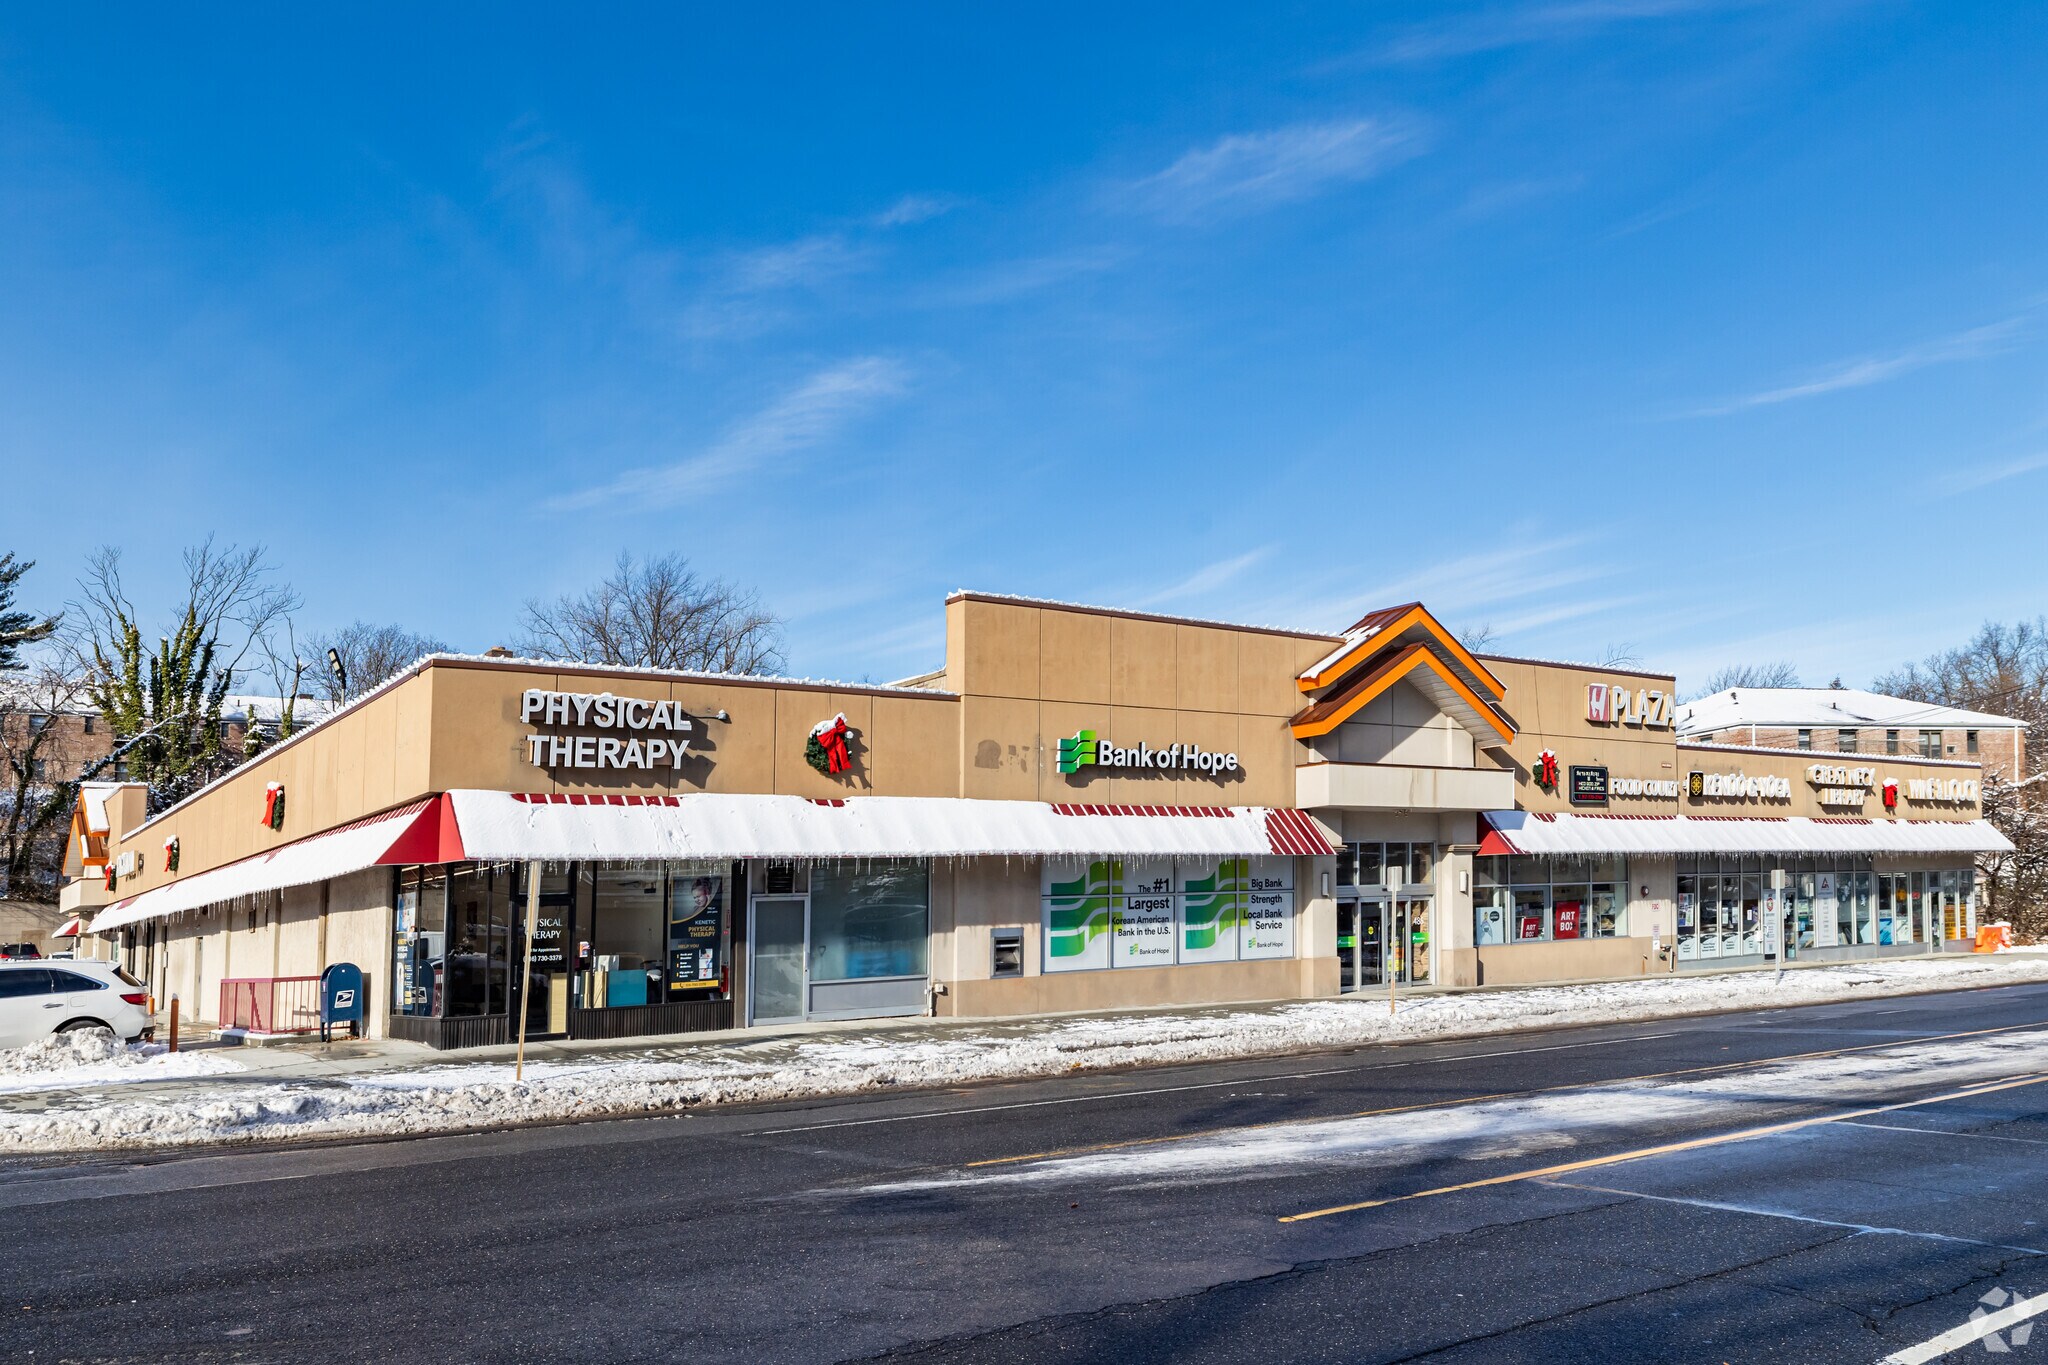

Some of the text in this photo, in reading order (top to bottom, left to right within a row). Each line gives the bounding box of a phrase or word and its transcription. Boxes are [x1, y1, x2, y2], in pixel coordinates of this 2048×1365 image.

[522, 691, 692, 731] PHYSICAL
[1612, 686, 1677, 728] PLAZA
[527, 734, 691, 770] THERAPY
[1099, 740, 1238, 776] Bank of Hope
[1813, 764, 1877, 786] GREAT NECK
[1611, 778, 1680, 798] FOOD COURT
[1703, 772, 1747, 797] KENDO
[1758, 774, 1791, 798] YOGA
[1909, 778, 1935, 800] WINE
[1944, 778, 1979, 805] LIQUOR
[1824, 788, 1866, 805] LIBRARY
[1138, 878, 1170, 893] The #1
[1251, 878, 1283, 890] Big Bank
[1128, 896, 1170, 912] Largest
[1251, 894, 1283, 905] Strength
[1112, 915, 1170, 925] Korean American
[1243, 909, 1283, 919] Local Bank
[1561, 911, 1576, 921] ART
[1118, 926, 1171, 937] Bank in the U.S.
[1255, 920, 1283, 930] Service
